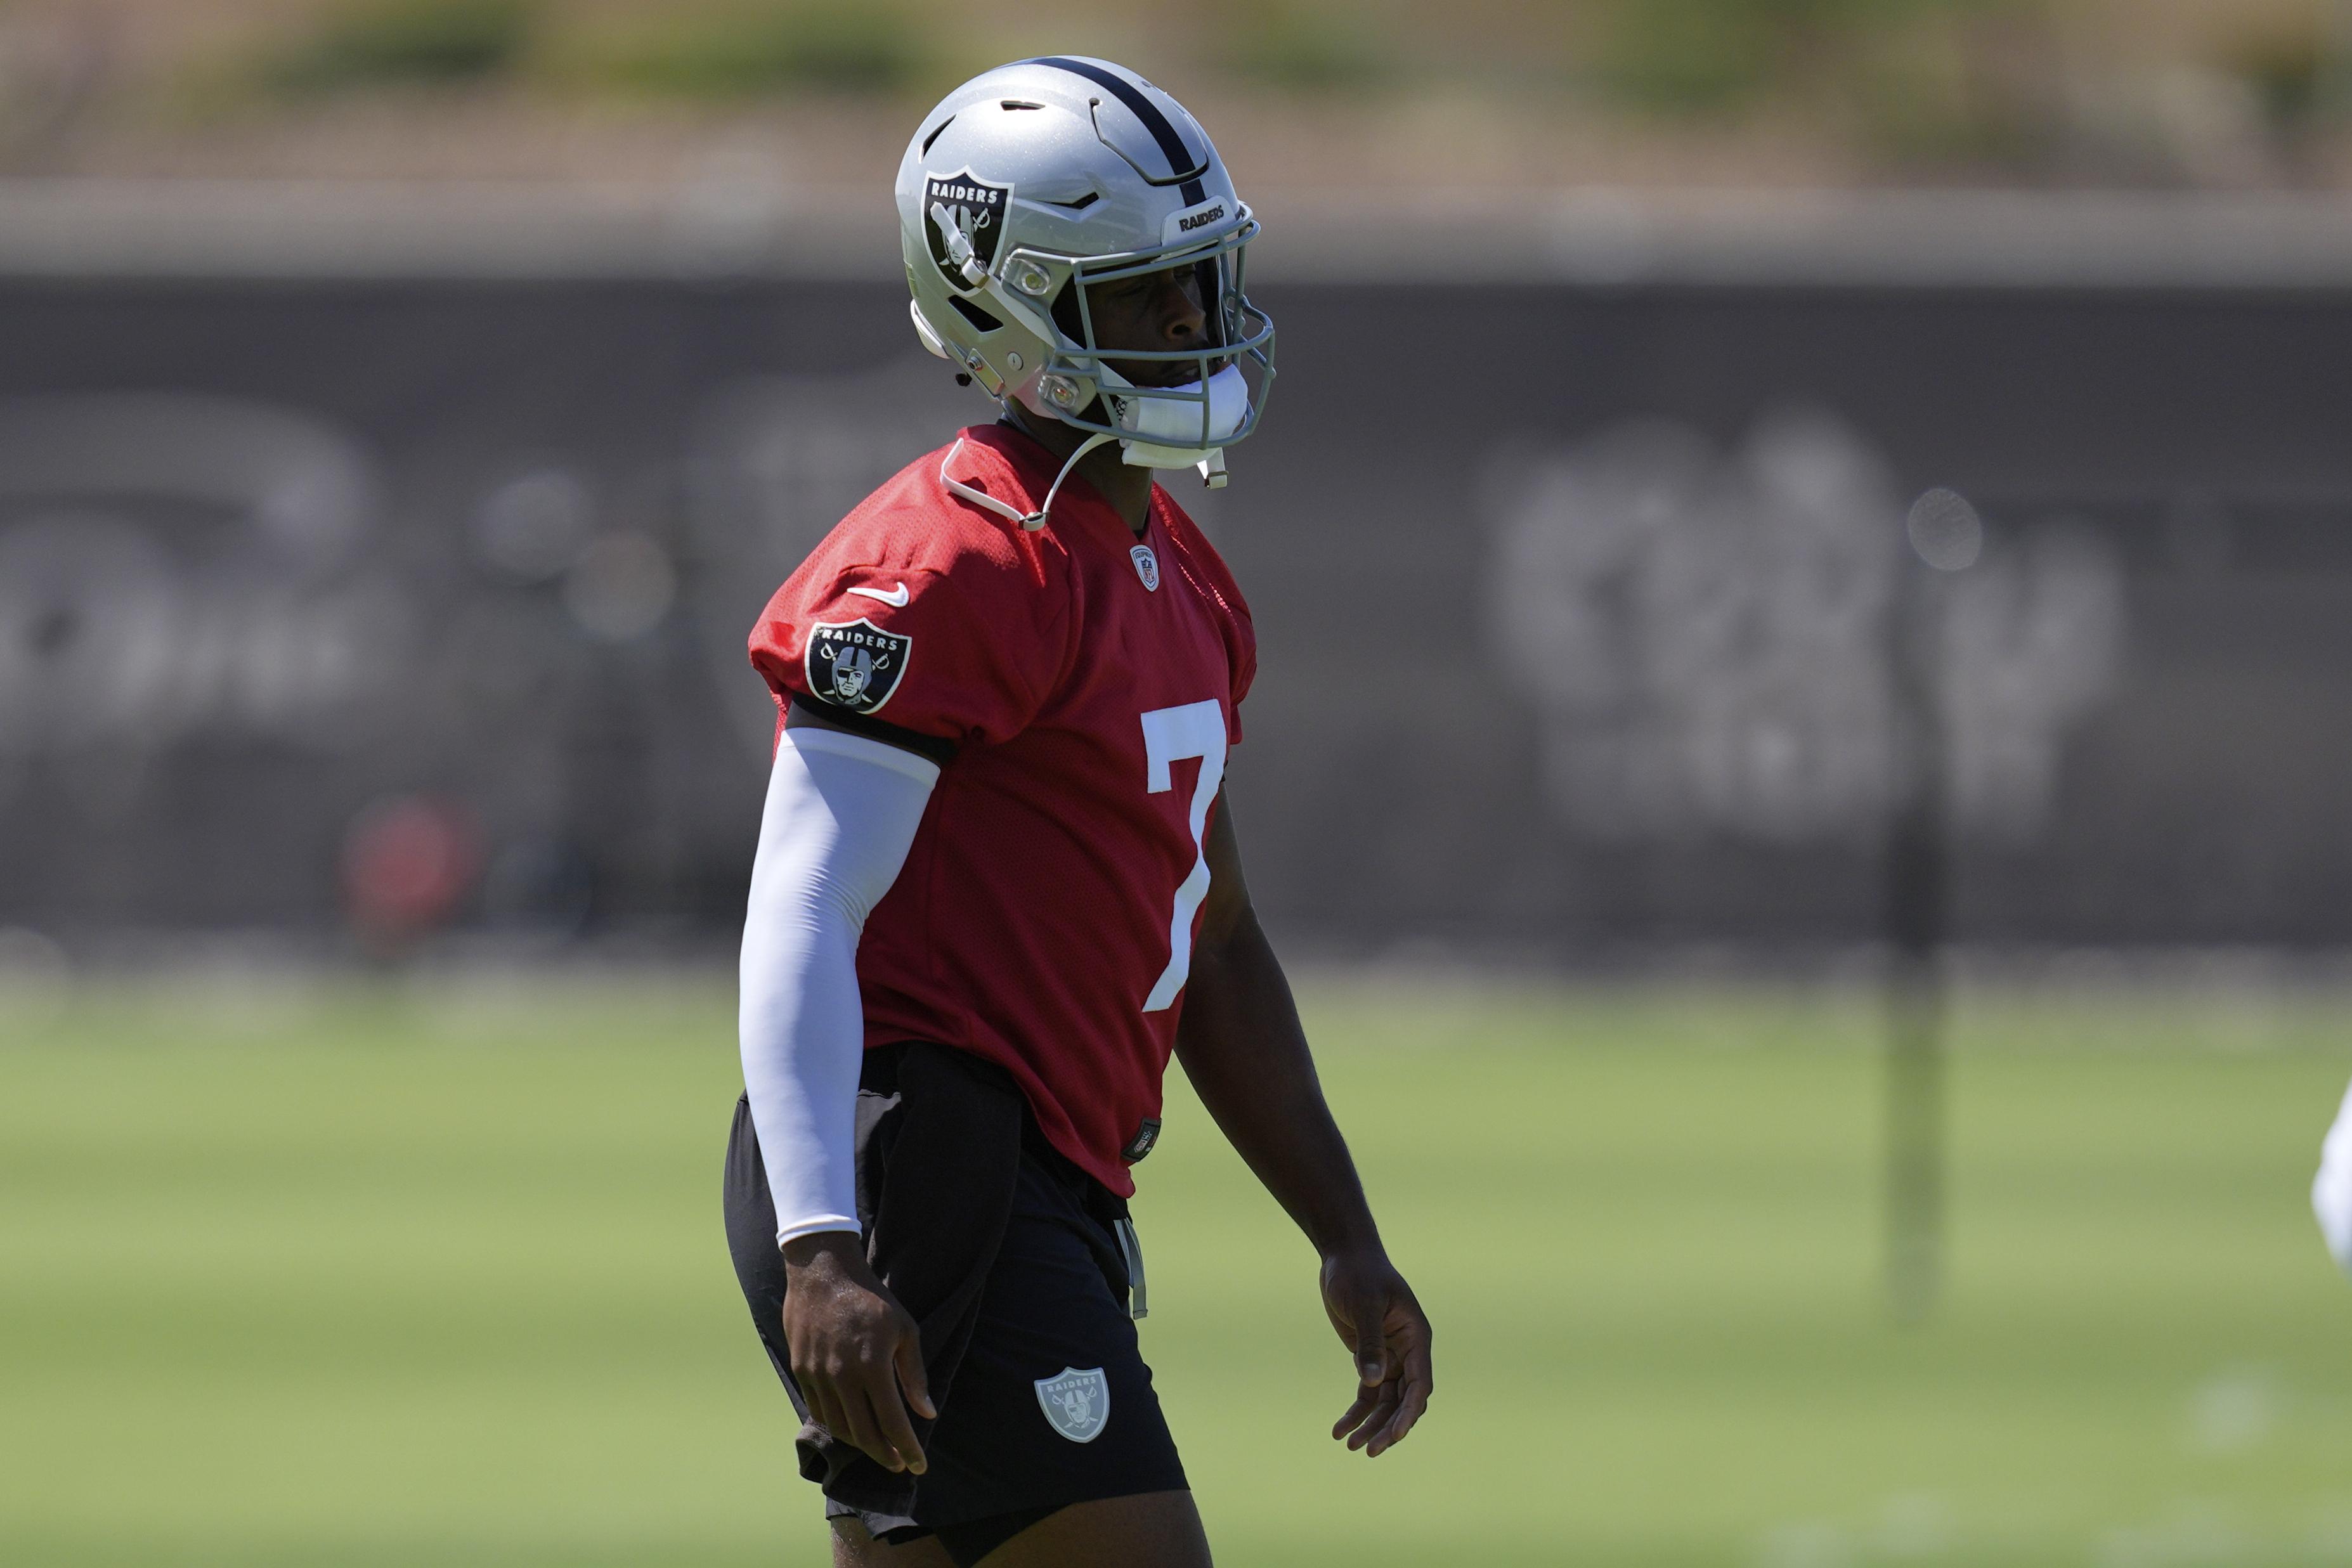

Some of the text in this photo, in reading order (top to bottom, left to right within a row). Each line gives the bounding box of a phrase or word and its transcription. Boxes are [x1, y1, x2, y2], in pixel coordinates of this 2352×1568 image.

[932, 182, 997, 204] RAIDERS
[1179, 205, 1224, 231] RAIDERS
[822, 629, 897, 651] RAIDERS
[1141, 699, 1227, 1013] 7
[1048, 1377, 1096, 1392] RAIDERS
